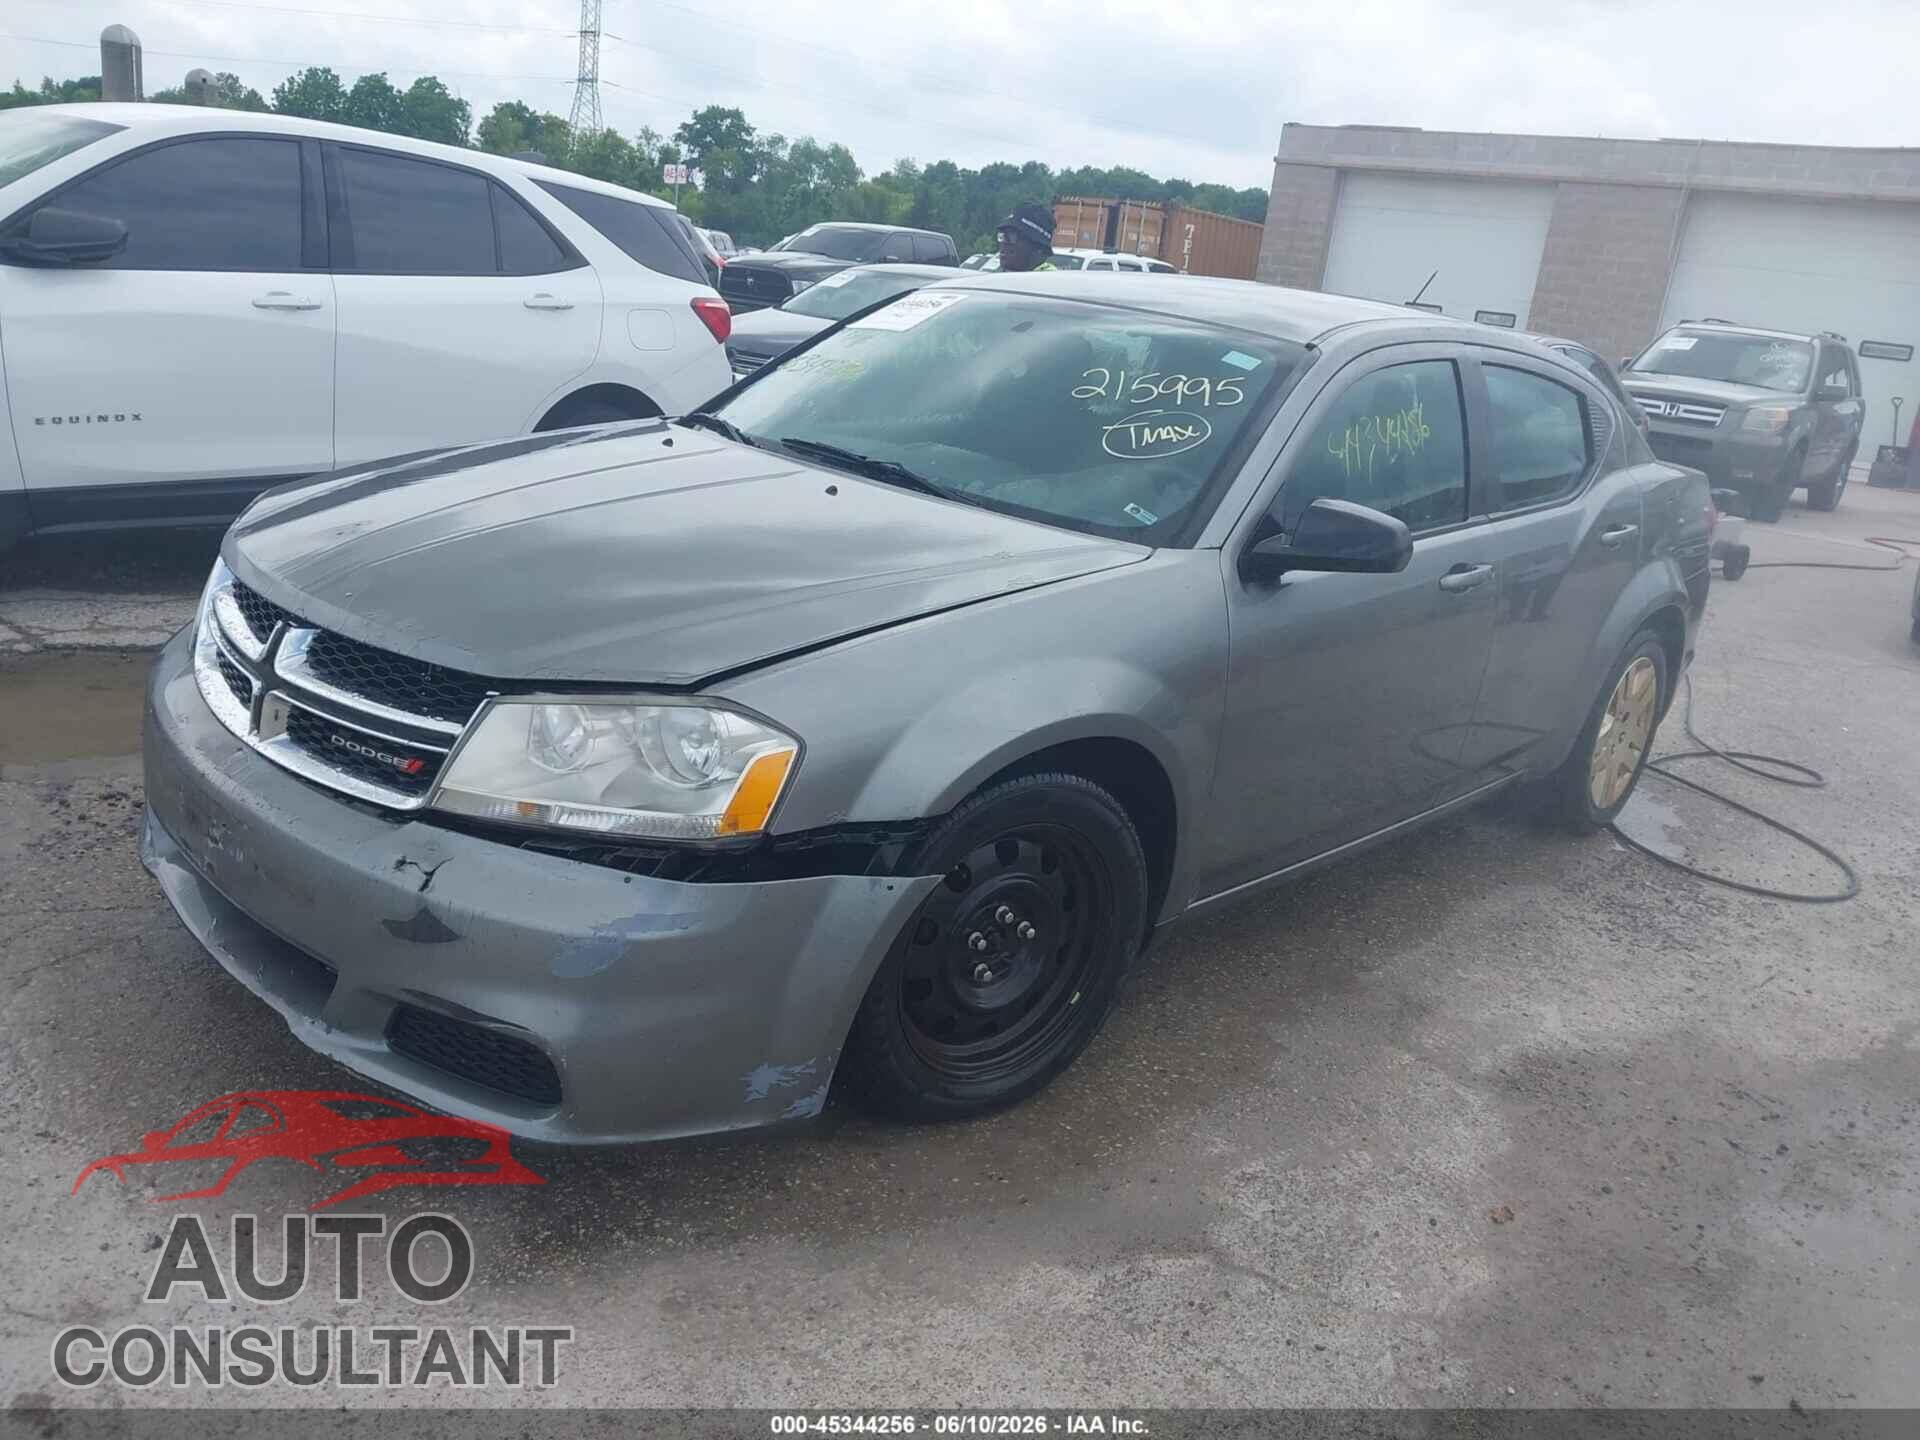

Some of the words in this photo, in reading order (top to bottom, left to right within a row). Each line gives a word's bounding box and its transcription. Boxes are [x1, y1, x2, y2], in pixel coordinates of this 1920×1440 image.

[1071, 367, 1246, 407] 215995
[34, 413, 143, 426] EQUINOX
[1103, 422, 1201, 450] TMAX
[331, 735, 409, 769] DODGE
